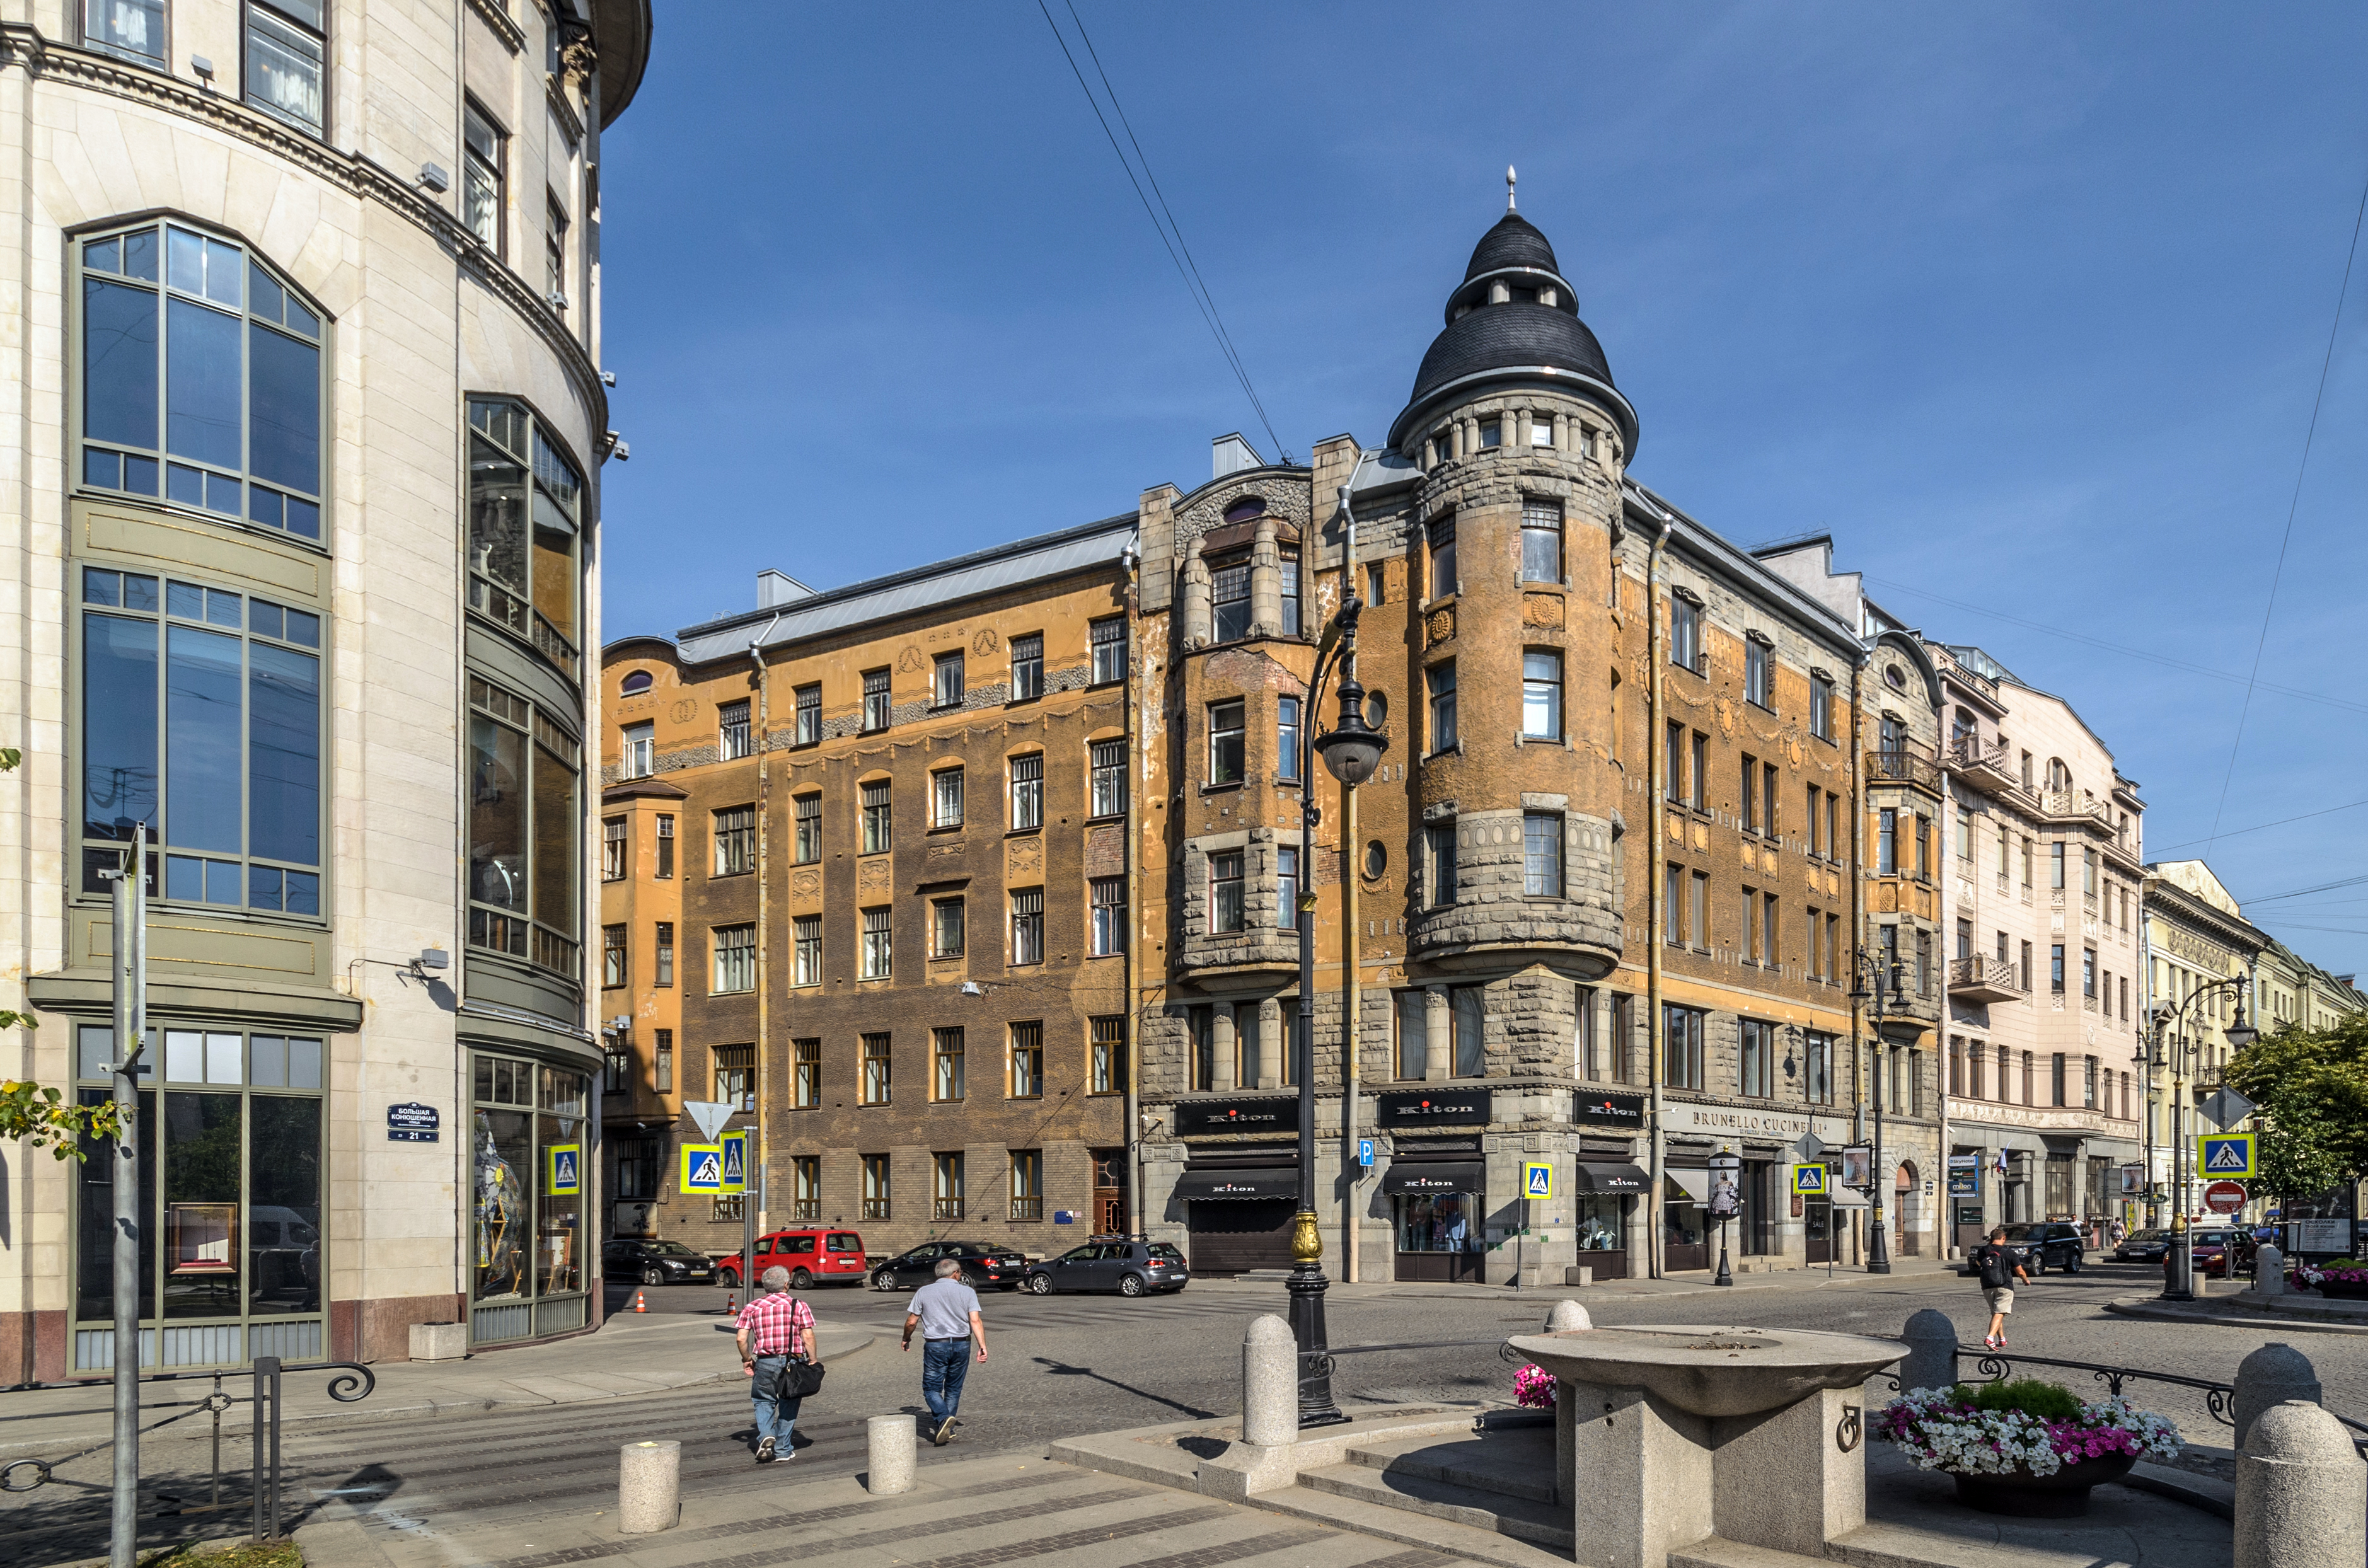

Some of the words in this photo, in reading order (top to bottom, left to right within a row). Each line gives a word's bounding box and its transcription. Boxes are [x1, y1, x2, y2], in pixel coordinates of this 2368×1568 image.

[1397, 1100, 1475, 1114] Kiton
[1588, 1102, 1638, 1117] Kiton
[391, 1114, 436, 1122] КОНЮШЕННАЯ
[1207, 1110, 1276, 1122] Kiton
[1693, 1112, 1759, 1129] BRUNELLO
[1404, 1178, 1453, 1187] Kiton
[1608, 1177, 1639, 1185] Kiton
[1212, 1184, 1256, 1192] Kiton
